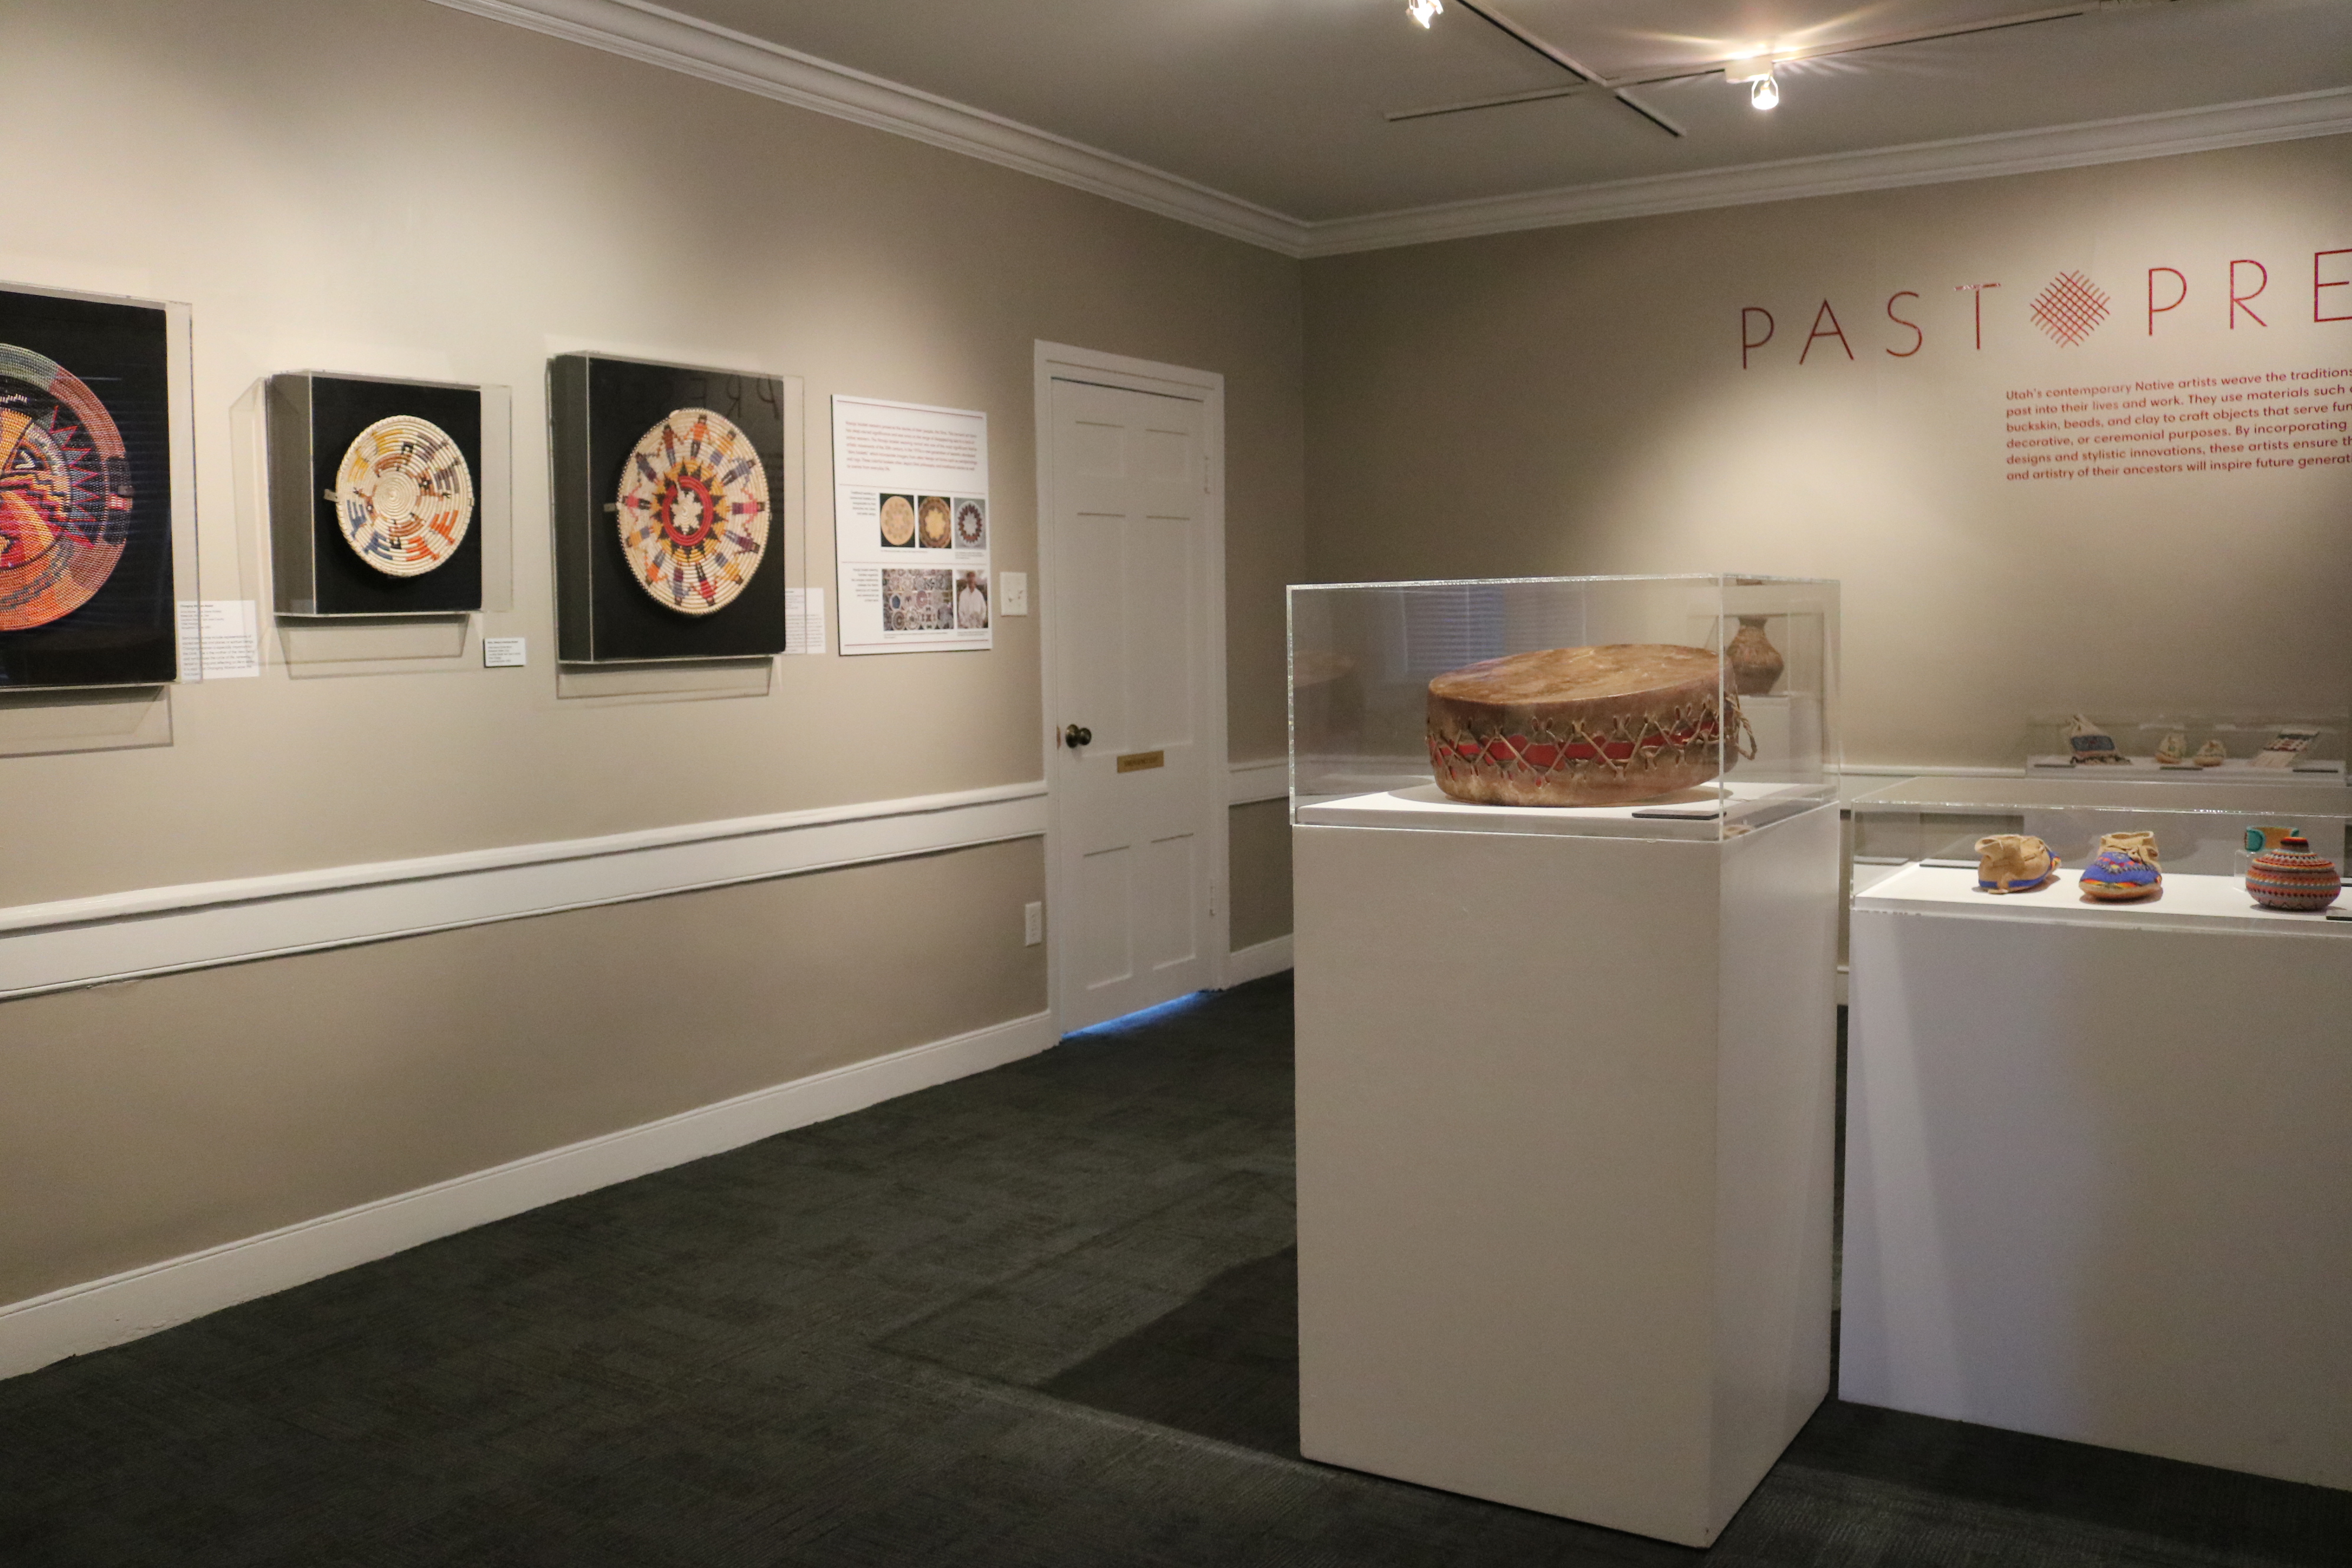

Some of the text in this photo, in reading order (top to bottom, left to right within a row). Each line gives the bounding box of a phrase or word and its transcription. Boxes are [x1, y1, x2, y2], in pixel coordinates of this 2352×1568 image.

[2006, 388, 2043, 400] Utah's
[2046, 384, 2131, 398] contemporary
[2136, 380, 2174, 391] Native
[2178, 377, 2217, 388] artists
[2221, 374, 2262, 385] weave
[2266, 372, 2286, 382] the
[2006, 406, 2031, 418] past
[2036, 404, 2057, 414] into
[2062, 403, 2089, 413] their
[2093, 400, 2118, 411] lives
[2122, 398, 2147, 409] and
[2151, 396, 2184, 406] work.
[2189, 394, 2216, 406] They
[2221, 392, 2243, 403] use
[2247, 387, 2309, 400] materials
[2314, 385, 2345, 396] such
[2007, 422, 2060, 432] buckskin,
[2064, 417, 2103, 429] beads,
[2108, 415, 2131, 426] and
[2135, 414, 2160, 426] clay
[2164, 413, 2175, 423] to
[2180, 411, 2209, 422] craft
[2213, 407, 2259, 422] objects
[2263, 406, 2289, 417] that
[2294, 404, 2328, 414] serve
[2007, 436, 2073, 449] decorative,
[2094, 430, 2164, 443] ceremonial
[2169, 427, 2231, 442] purposes.
[2236, 425, 2250, 437] By
[2254, 419, 2347, 435] incorporating
[2007, 453, 2052, 466] designs
[2055, 451, 2078, 462] and
[2083, 449, 2126, 463] stylistic
[2130, 444, 2206, 458] innovations,
[2210, 443, 2245, 453] these
[2249, 440, 2289, 452] artists
[2293, 437, 2338, 449] ensure
[2007, 469, 2029, 481] and
[2033, 468, 2073, 480] artistry
[2077, 466, 2089, 477] of
[2093, 465, 2119, 476] their
[2123, 463, 2183, 475] ancestors
[2187, 461, 2207, 471] will
[2210, 458, 2252, 472] inspire
[2256, 457, 2294, 468] future
